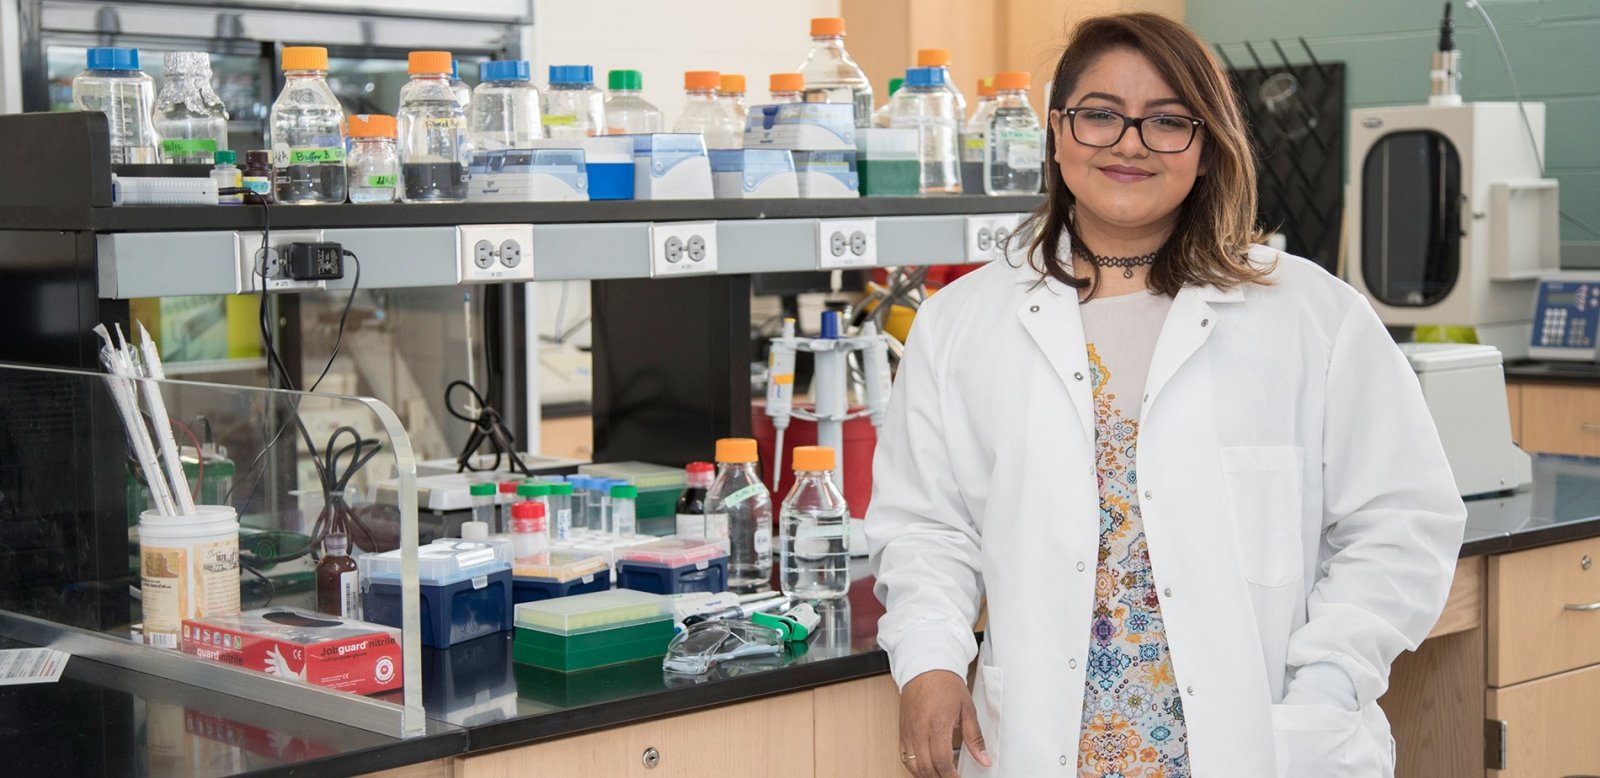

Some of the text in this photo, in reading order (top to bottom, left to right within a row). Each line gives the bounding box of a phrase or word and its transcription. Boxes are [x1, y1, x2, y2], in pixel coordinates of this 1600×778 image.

[295, 151, 321, 162] Buffer
[323, 150, 330, 159] B
[321, 637, 396, 656] Jobguard nitrile
